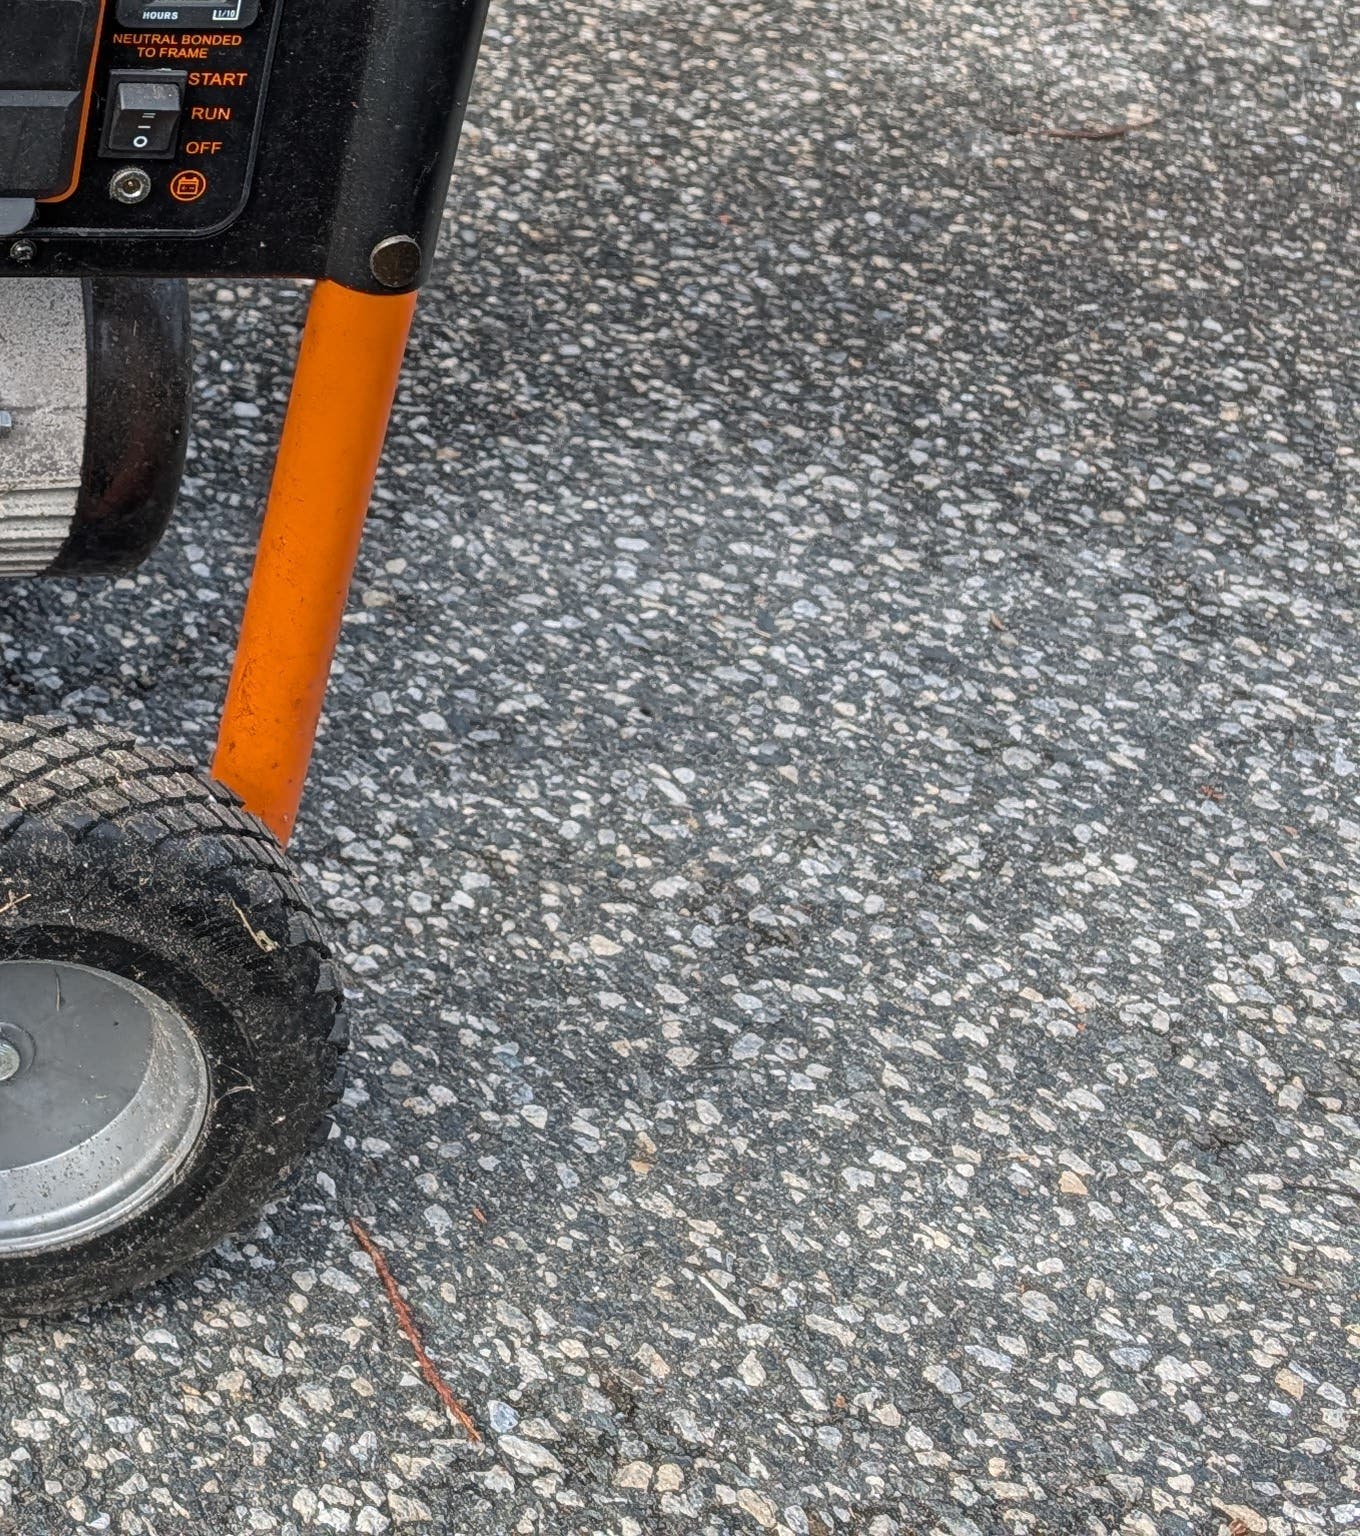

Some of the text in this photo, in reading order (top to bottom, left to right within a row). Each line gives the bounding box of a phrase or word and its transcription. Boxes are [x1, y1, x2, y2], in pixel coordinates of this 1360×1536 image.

[142, 11, 179, 20] HOURS
[113, 33, 243, 46] NEUTRAL BONDED
[137, 47, 209, 59] TO FRAME
[188, 72, 248, 86] START
[191, 107, 231, 120] RUN
[186, 141, 222, 155] OFF
